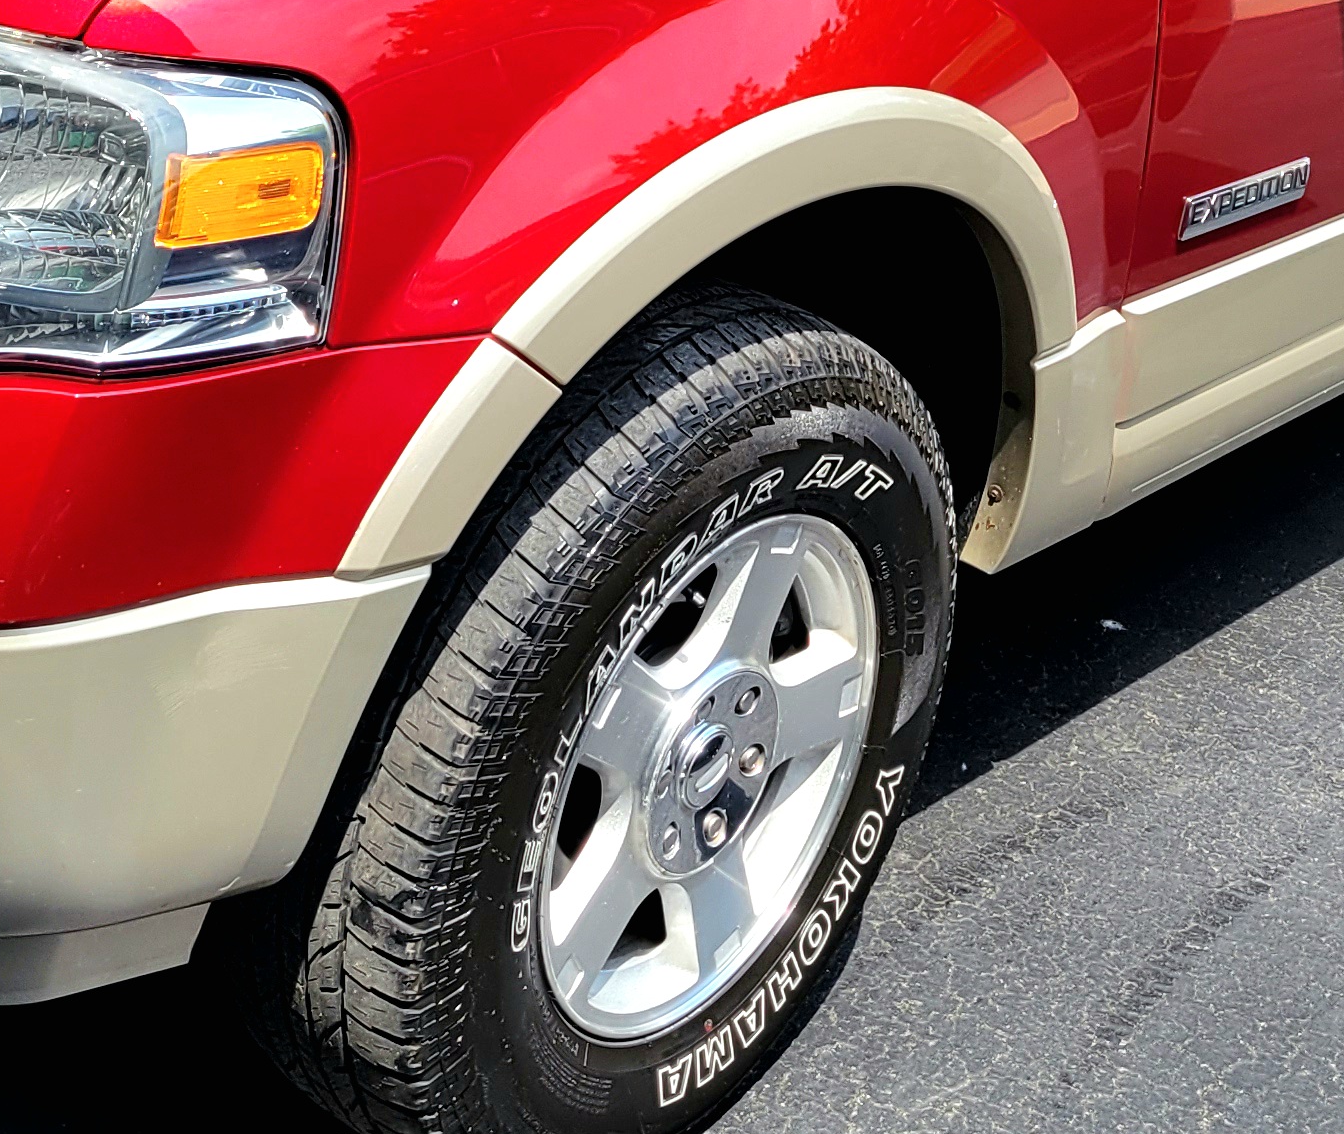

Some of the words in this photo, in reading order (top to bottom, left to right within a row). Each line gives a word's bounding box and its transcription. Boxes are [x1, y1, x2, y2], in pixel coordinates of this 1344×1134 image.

[1191, 162, 1309, 226] EXPEDITION
[794, 453, 895, 501] A/T
[658, 765, 905, 1108] YOKOHAMA
